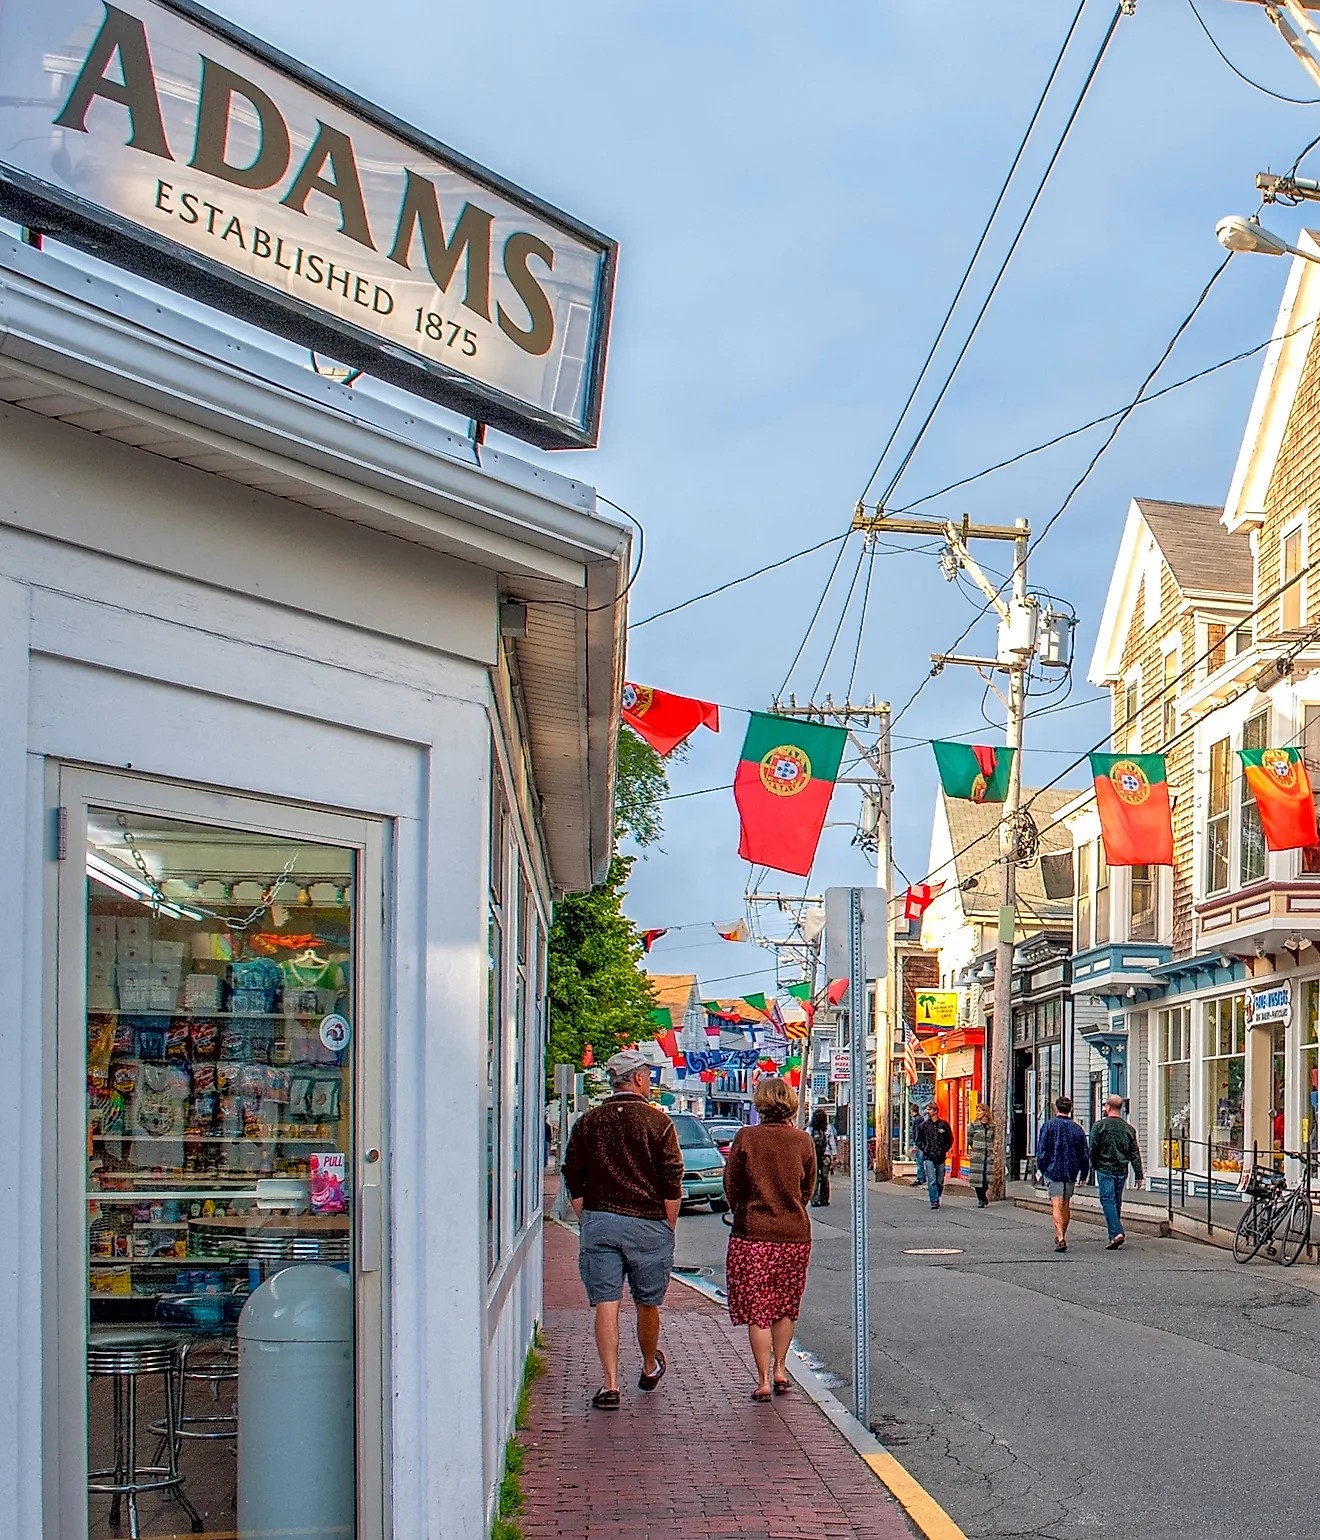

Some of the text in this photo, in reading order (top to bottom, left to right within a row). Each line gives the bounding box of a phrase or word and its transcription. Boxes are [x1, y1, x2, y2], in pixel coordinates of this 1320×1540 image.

[53, 5, 557, 358] ADAMS
[155, 179, 478, 358] ESTABLISHED 1875
[323, 1156, 343, 1167] PULL
